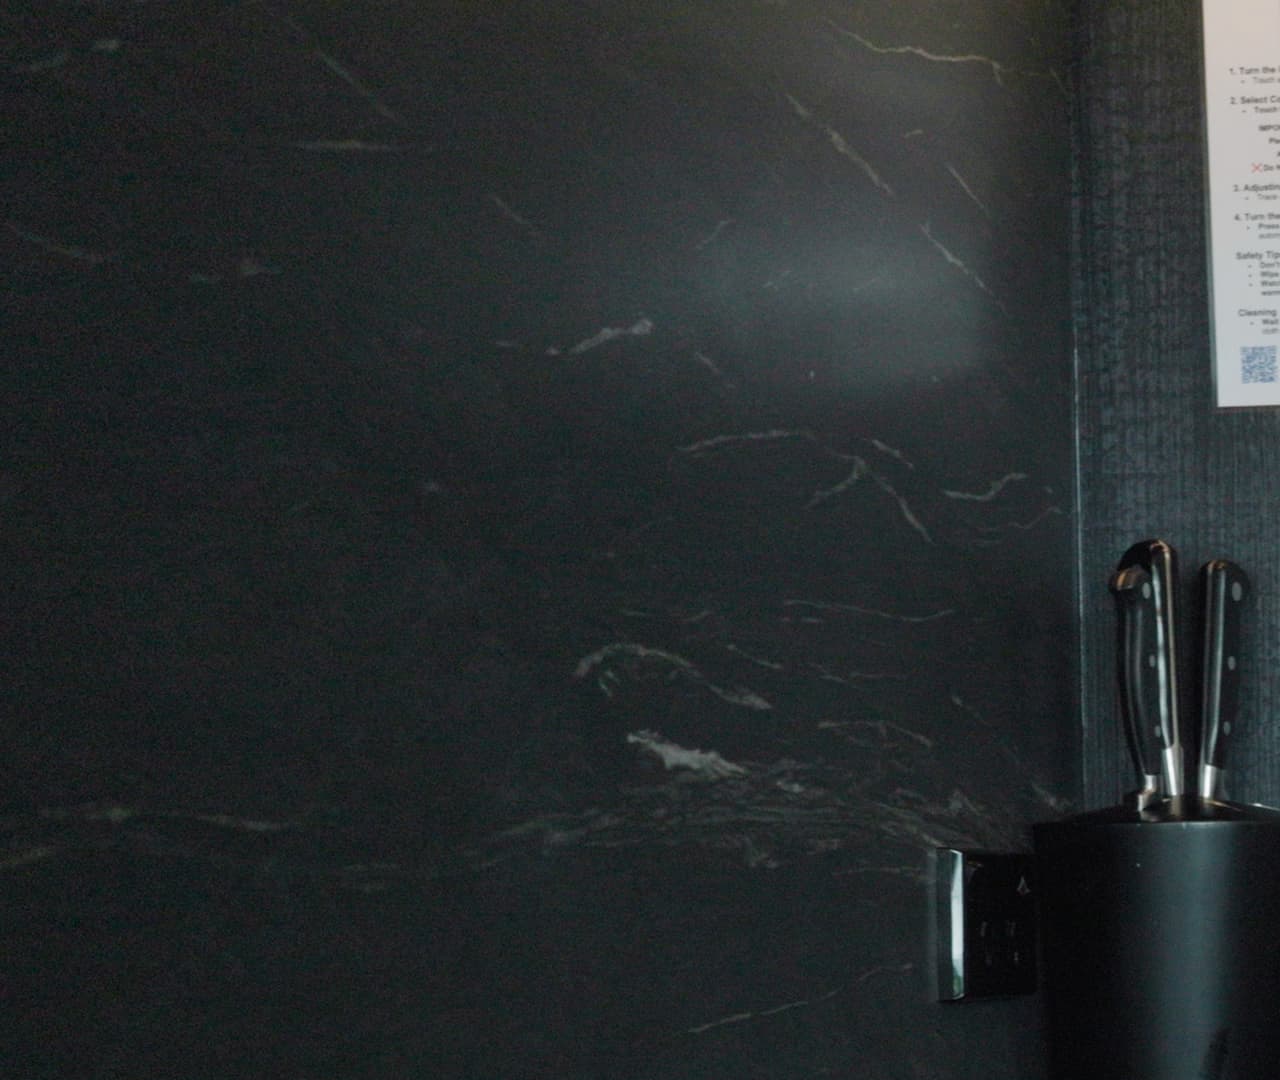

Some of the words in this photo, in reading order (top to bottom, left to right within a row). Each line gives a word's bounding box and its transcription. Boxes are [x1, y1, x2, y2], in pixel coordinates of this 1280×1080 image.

[1240, 95, 1267, 104] Select
[1236, 251, 1263, 260] Safety
[1238, 308, 1277, 317] Cleaning
